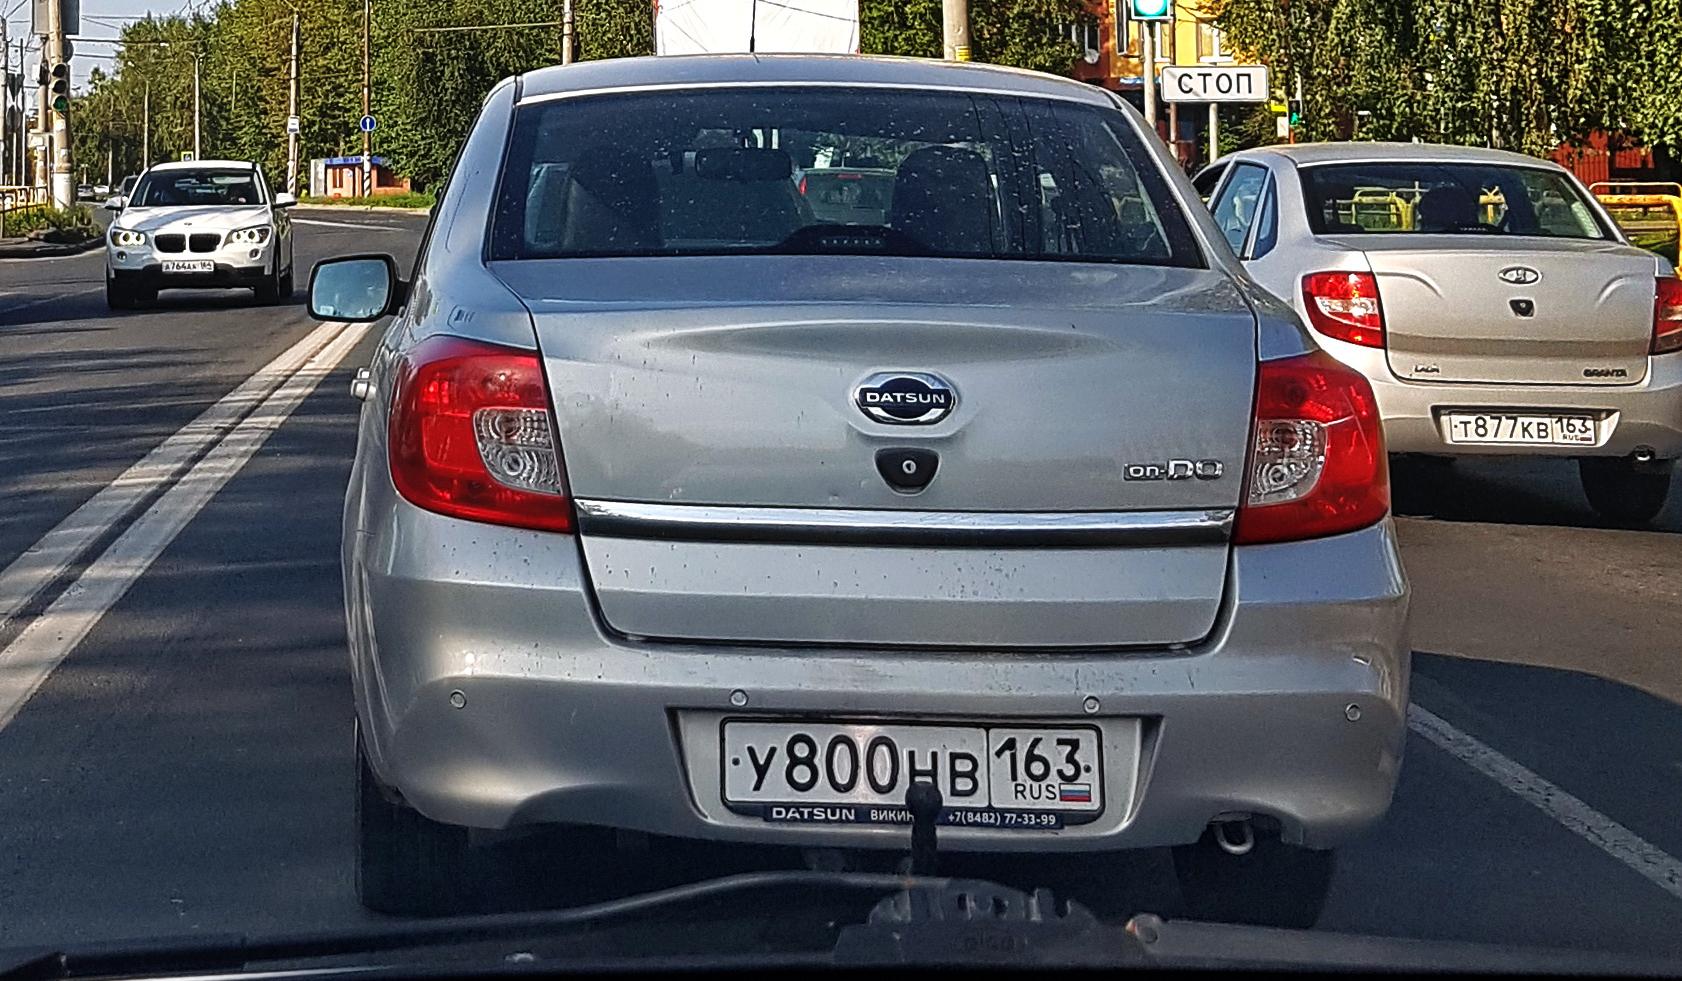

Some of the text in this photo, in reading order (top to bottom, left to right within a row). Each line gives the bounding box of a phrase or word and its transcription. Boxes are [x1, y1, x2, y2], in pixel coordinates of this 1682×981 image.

[1177, 72, 1252, 94] СТОП
[866, 392, 945, 403] DATSUN
[1459, 416, 1588, 438] Т877КВ 163
[746, 733, 1082, 797] У800НВ 163
[1014, 783, 1057, 800] RUS
[772, 807, 1056, 826] DATSUN ВИКИН +7(8482) 77-33-99
